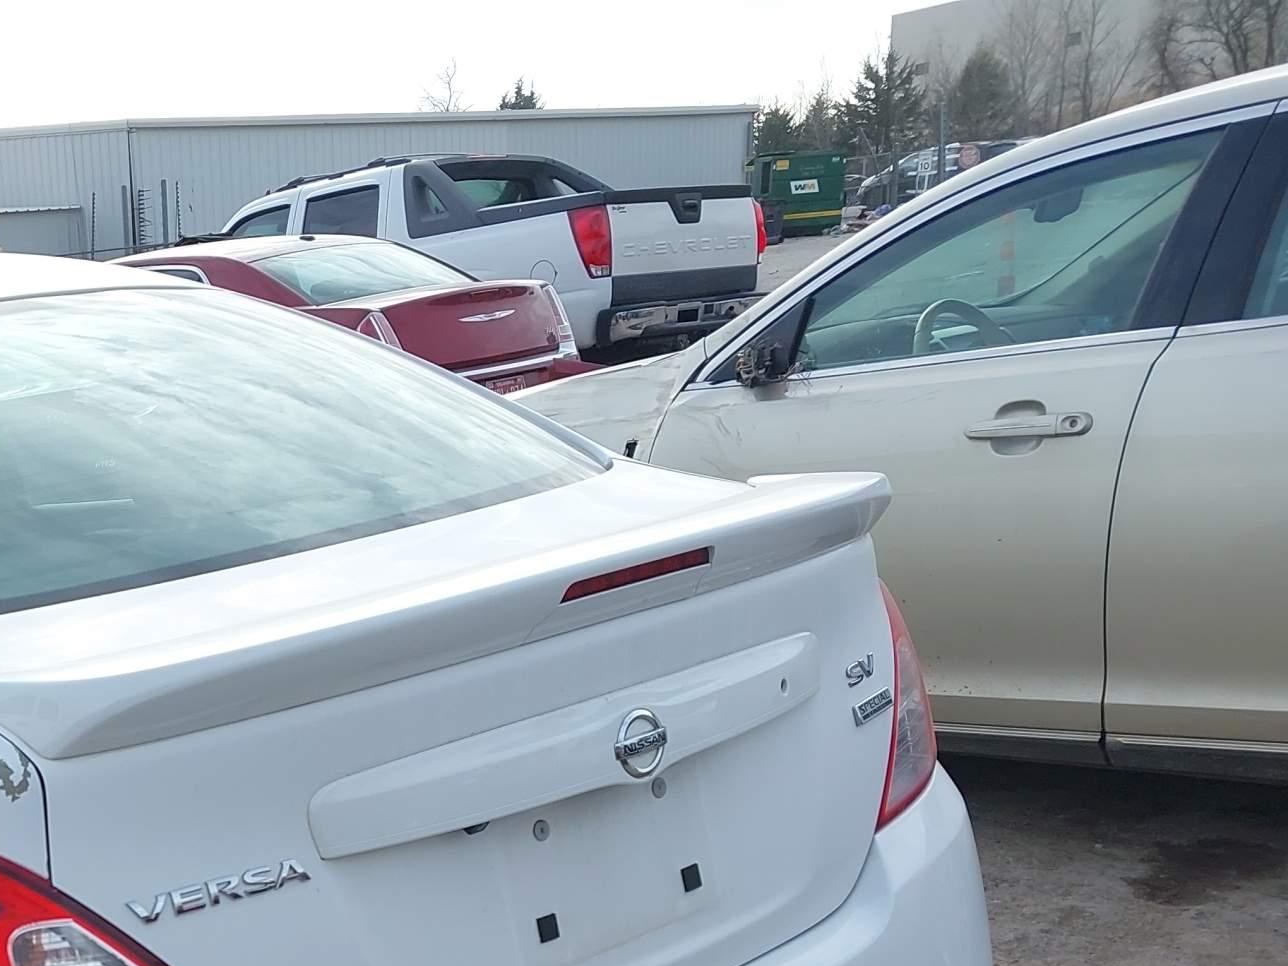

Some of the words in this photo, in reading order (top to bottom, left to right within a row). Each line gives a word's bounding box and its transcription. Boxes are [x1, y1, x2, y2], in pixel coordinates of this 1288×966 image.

[920, 162, 930, 170] 10
[794, 182, 816, 191] WM
[622, 235, 752, 257] CHEVROLET
[845, 651, 874, 688] SV
[857, 690, 891, 716] SPECIAL
[623, 732, 665, 754] NISSAN
[125, 858, 311, 924] VERSA
